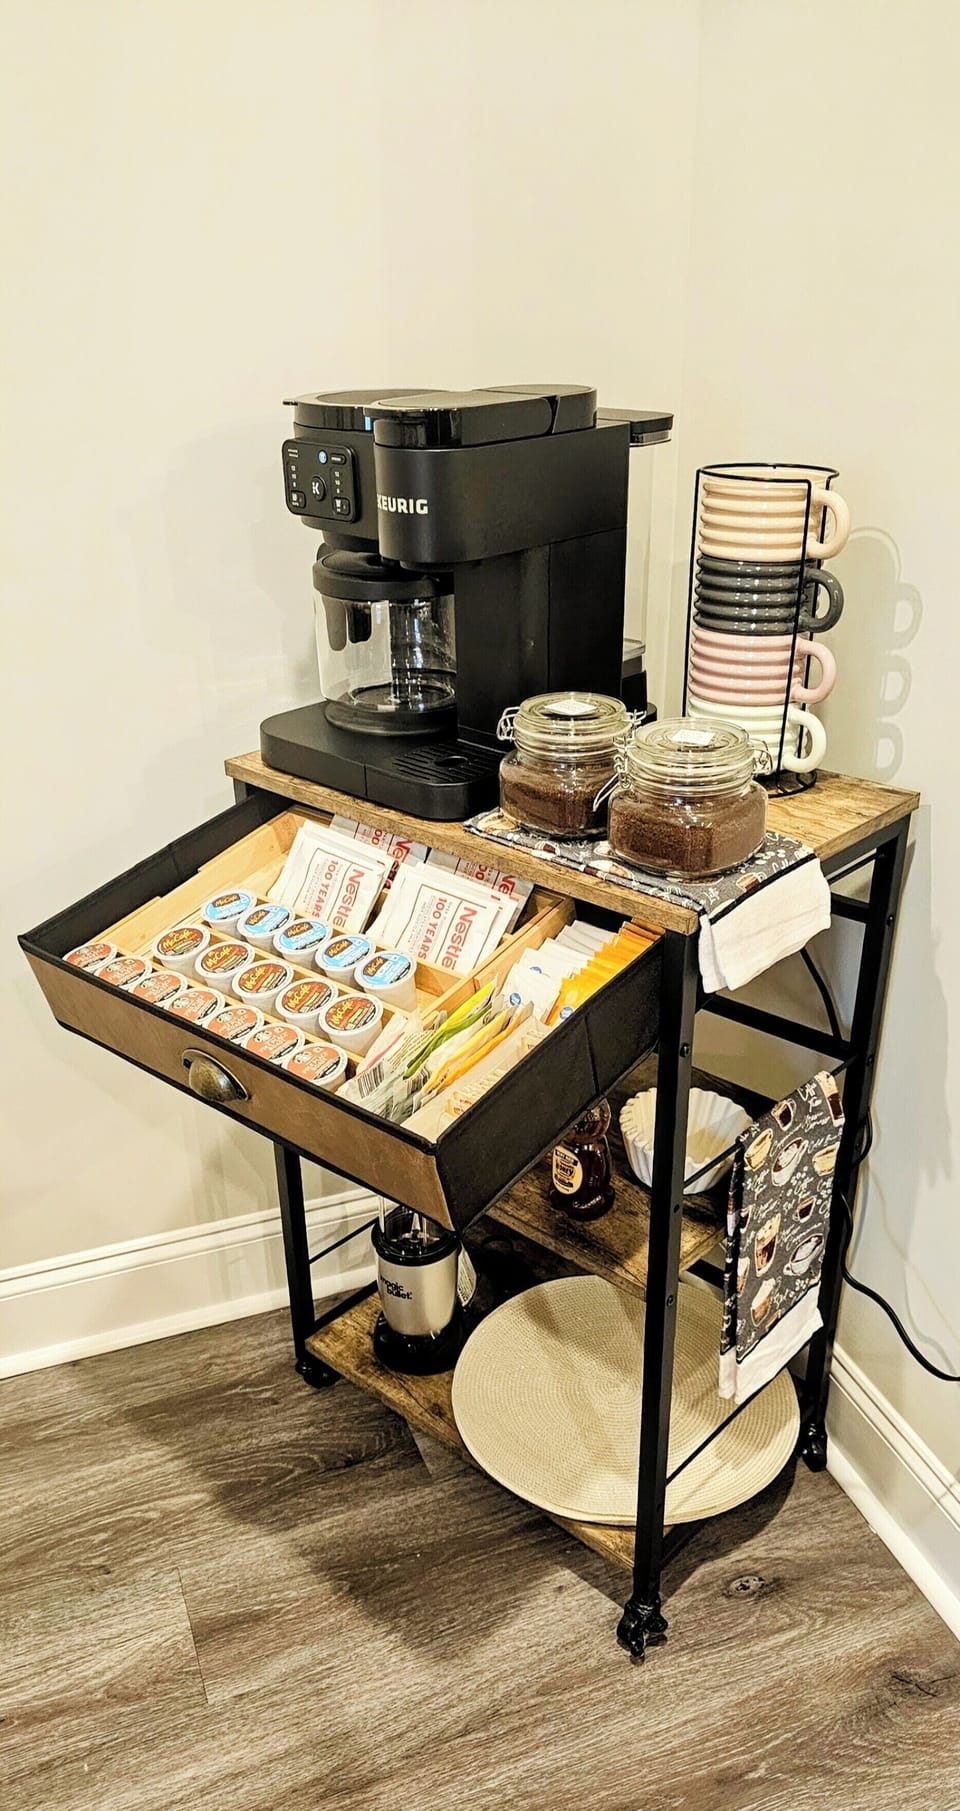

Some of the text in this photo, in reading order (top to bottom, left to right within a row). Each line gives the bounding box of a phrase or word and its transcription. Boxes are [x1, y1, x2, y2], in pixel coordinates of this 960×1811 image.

[376, 493, 429, 515] KEURIG
[311, 859, 339, 918] 100 YEARS
[432, 896, 448, 920] 100
[417, 921, 439, 960] YEARS
